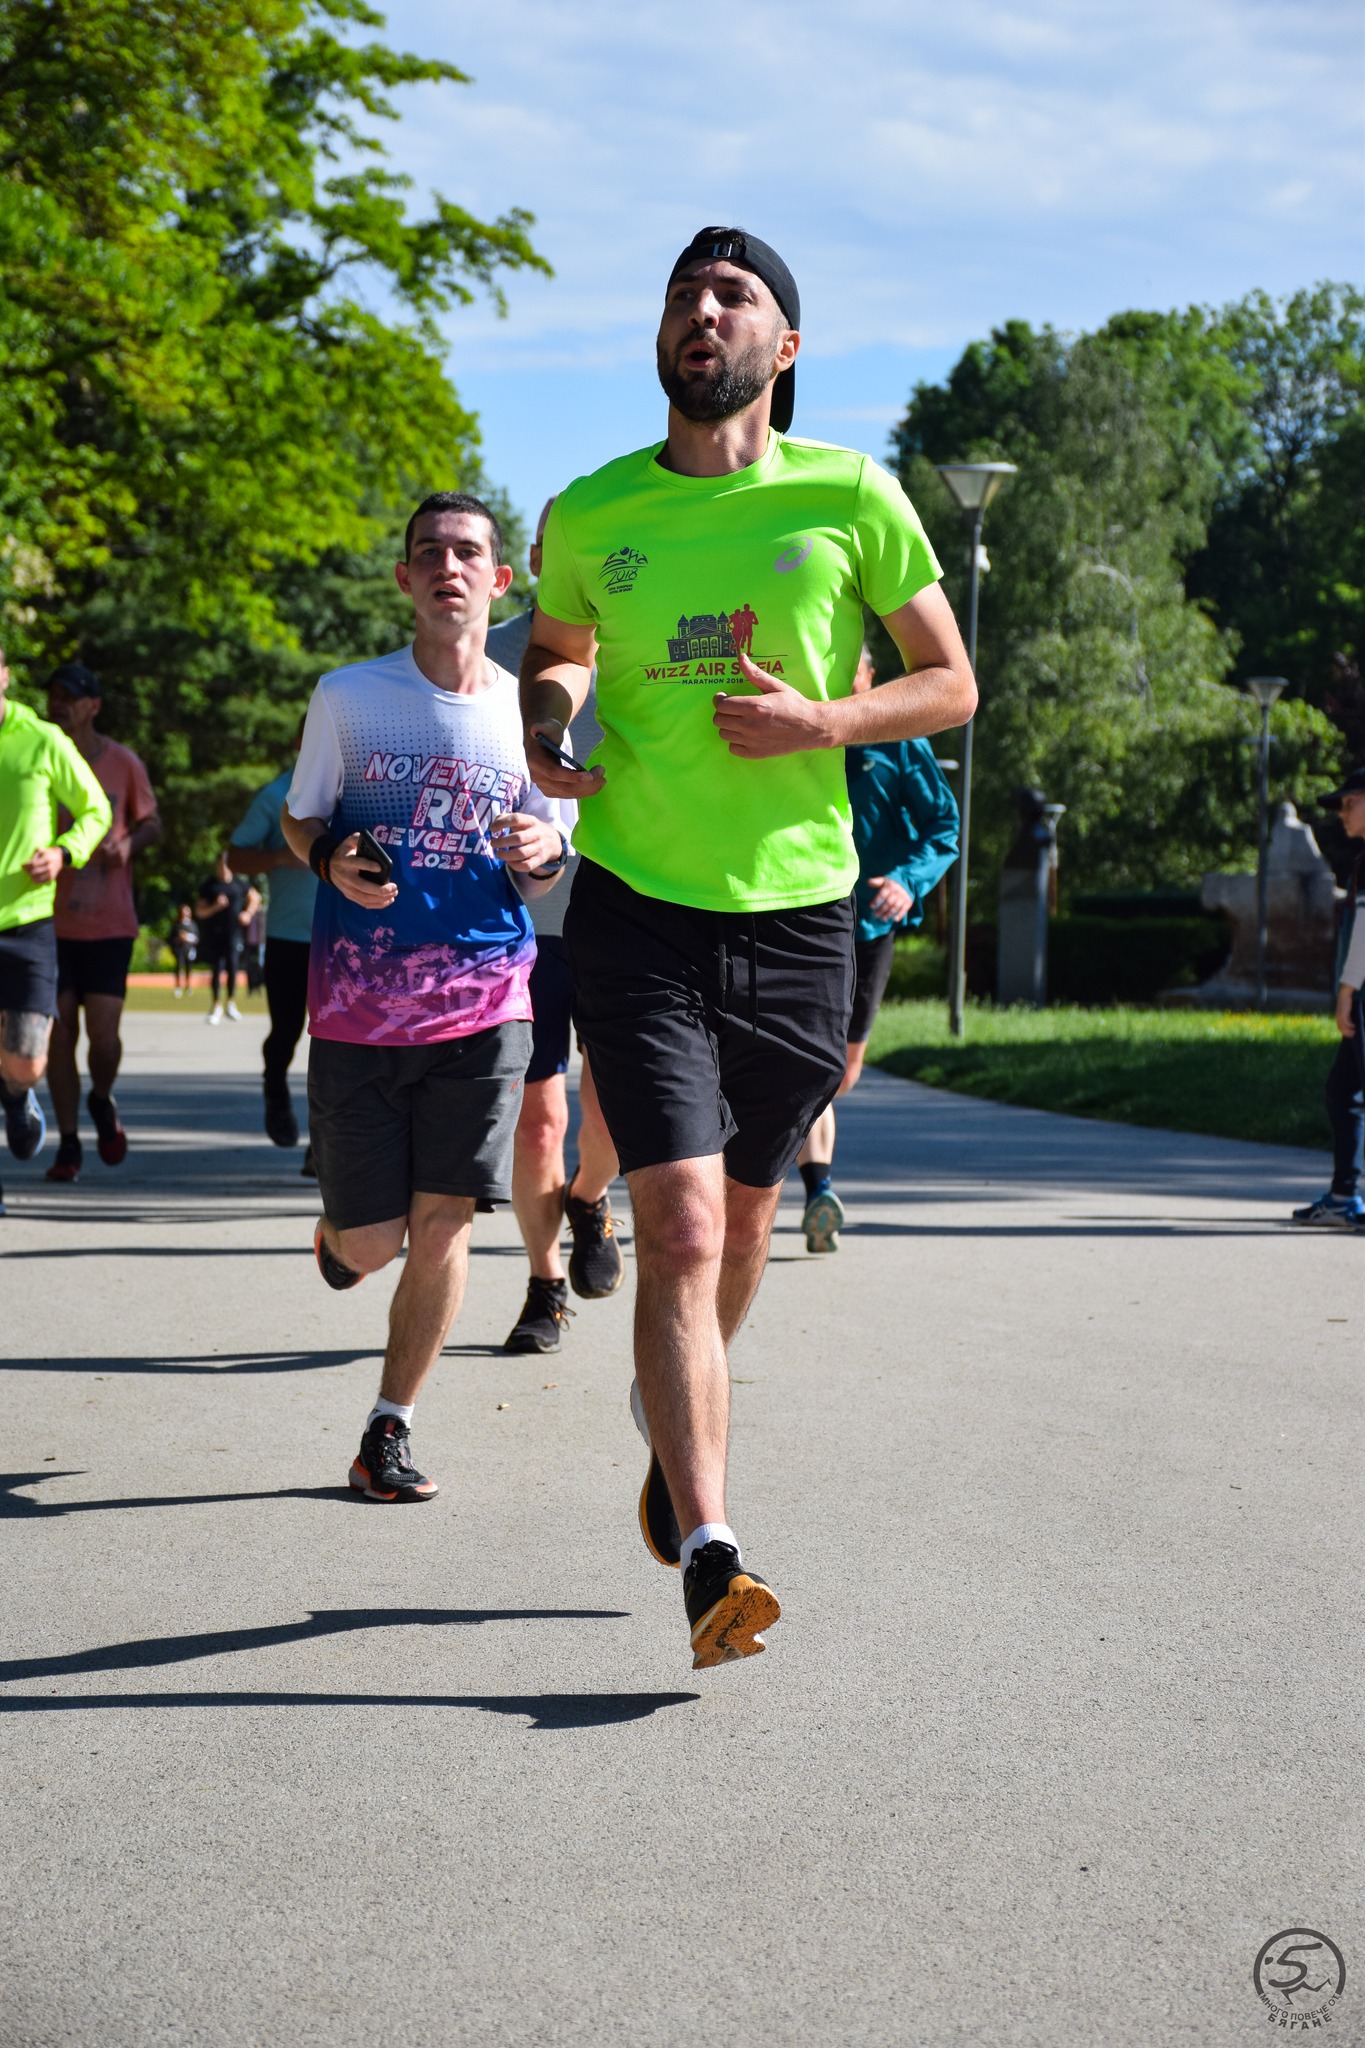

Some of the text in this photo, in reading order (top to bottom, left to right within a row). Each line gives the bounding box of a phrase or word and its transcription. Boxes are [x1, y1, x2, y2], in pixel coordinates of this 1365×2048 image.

[603, 567, 637, 589] 2018
[643, 660, 784, 681] WIZZ AIR SFIA
[410, 851, 465, 871] 2023
